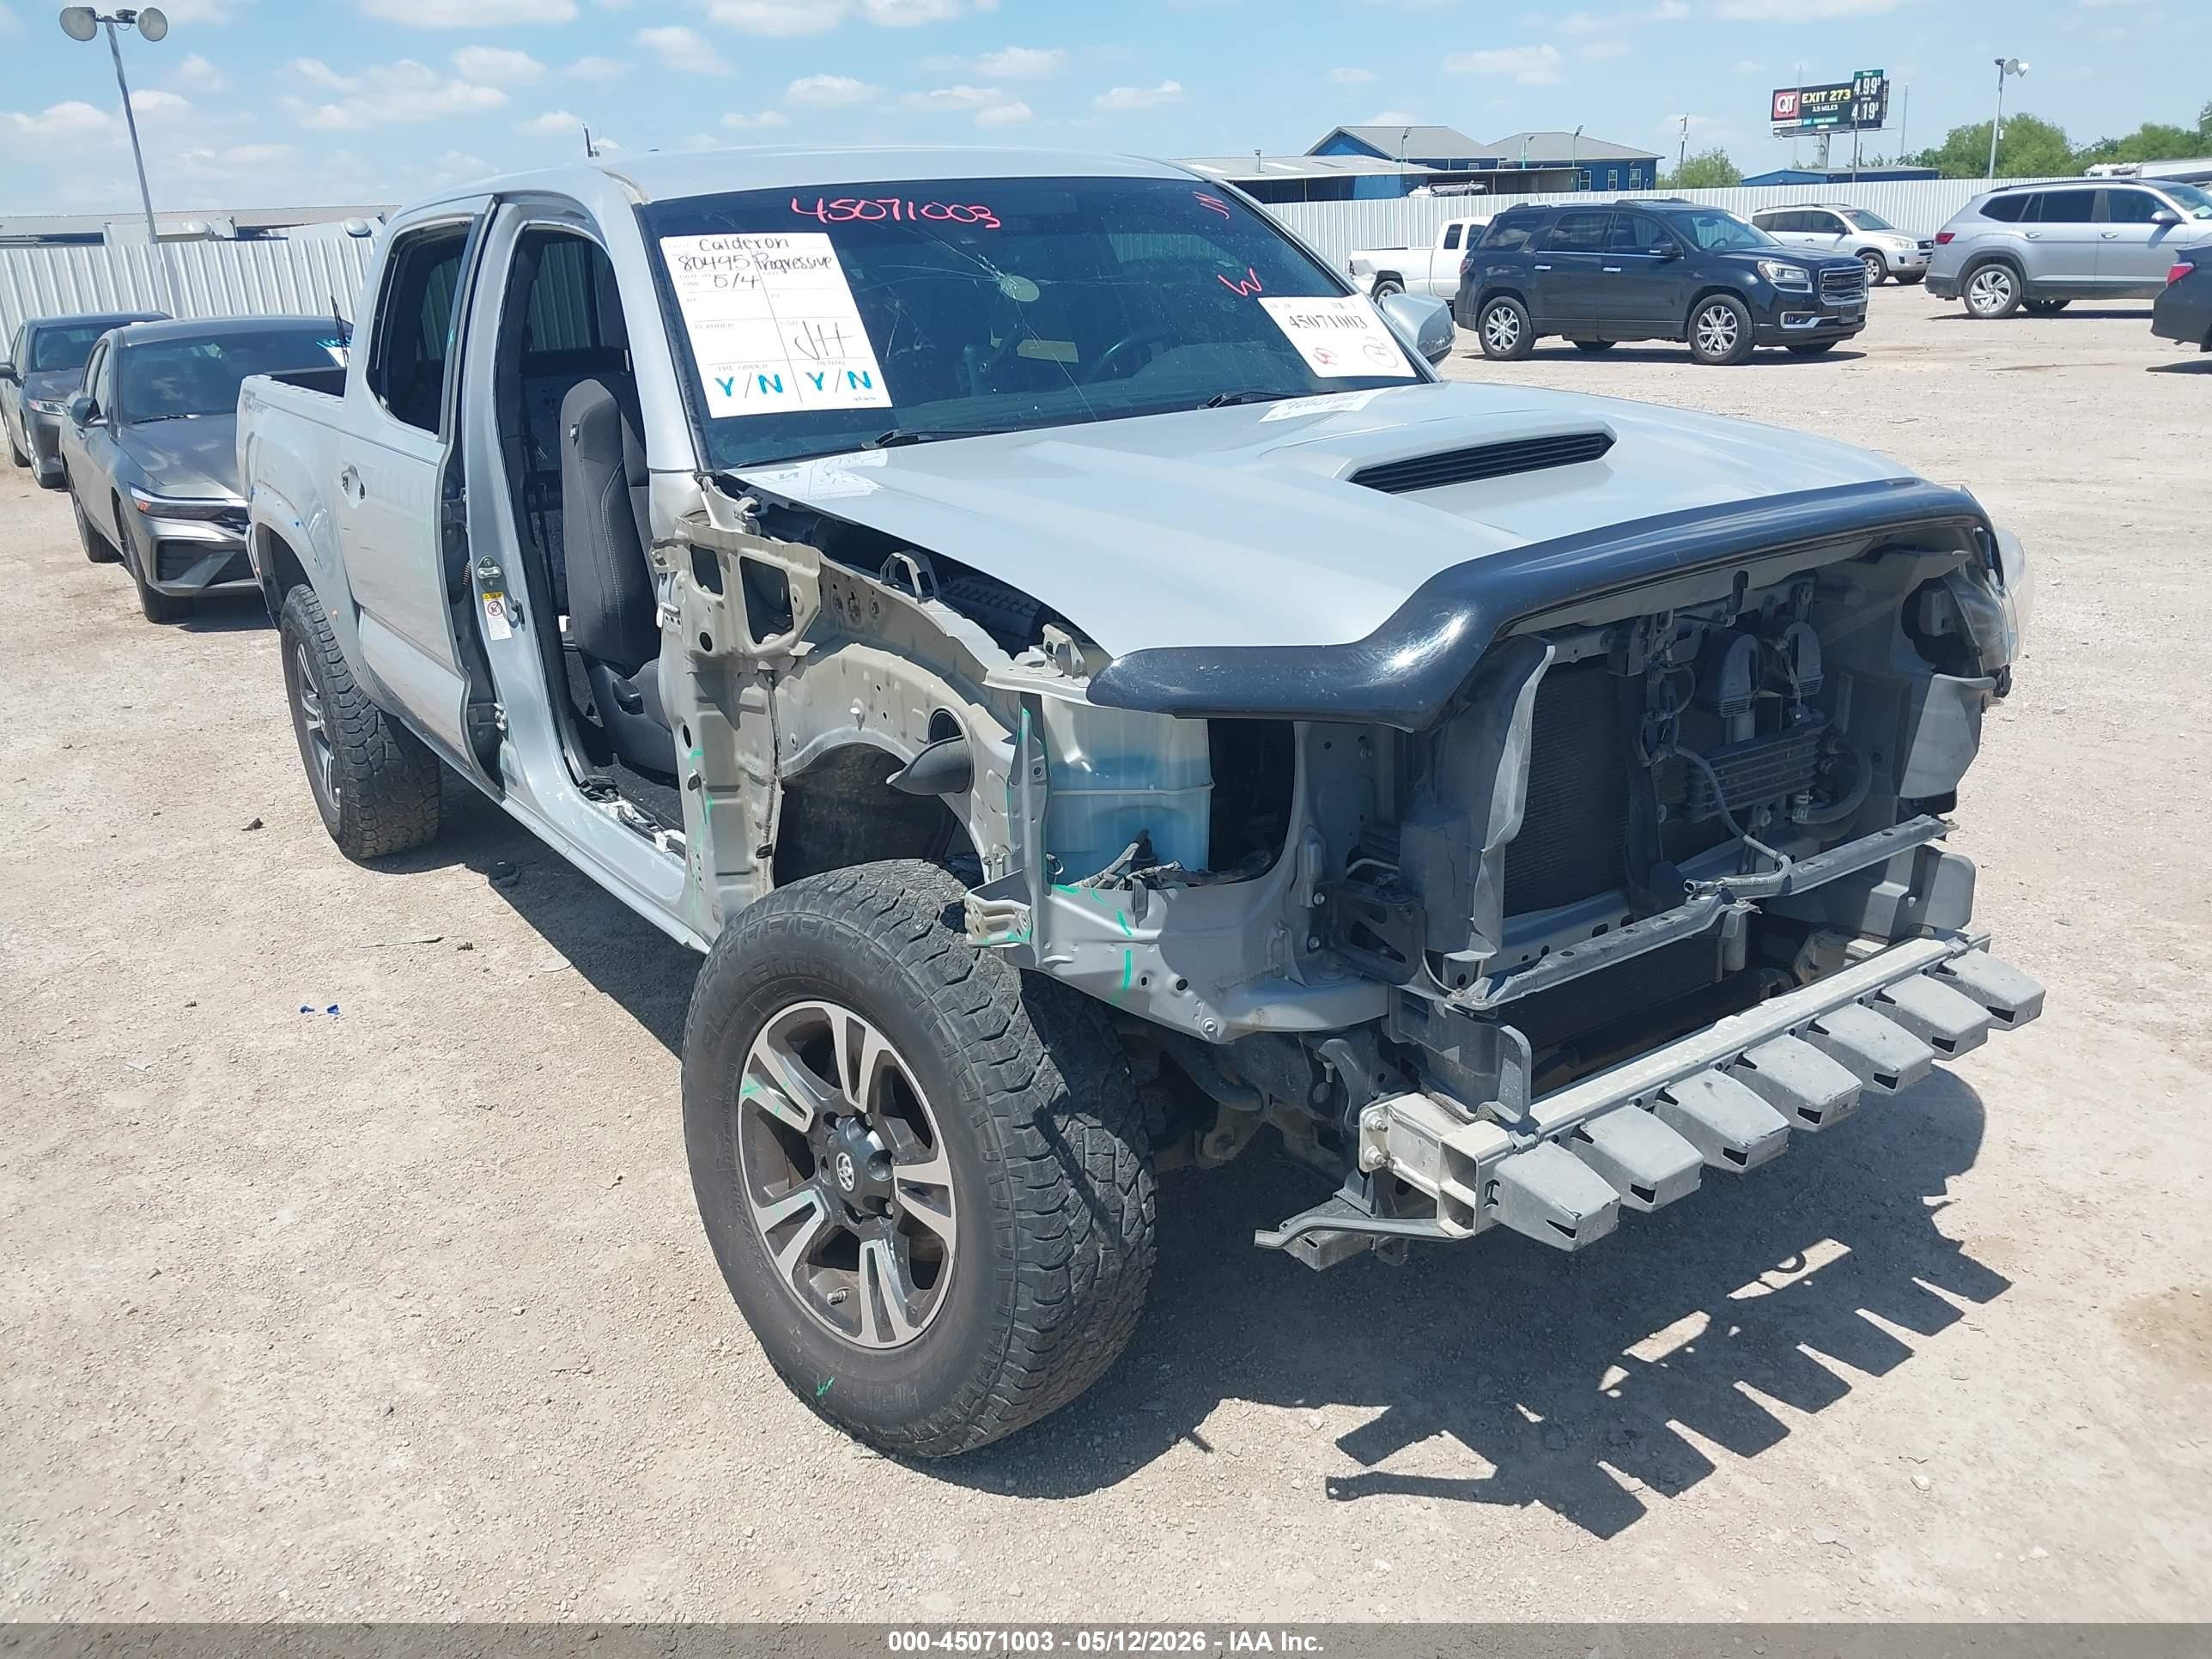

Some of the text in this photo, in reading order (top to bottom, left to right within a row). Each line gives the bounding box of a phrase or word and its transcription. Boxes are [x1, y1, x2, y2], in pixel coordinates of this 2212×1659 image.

[1776, 94, 1796, 115] QT
[1802, 88, 1851, 104] EXIT 273
[791, 198, 1001, 228] 45071003
[699, 236, 789, 251] Calderon
[678, 254, 750, 271] 80495
[753, 252, 832, 274] Progressive
[714, 272, 760, 289] 5/4
[1289, 315, 1368, 330] 45071003
